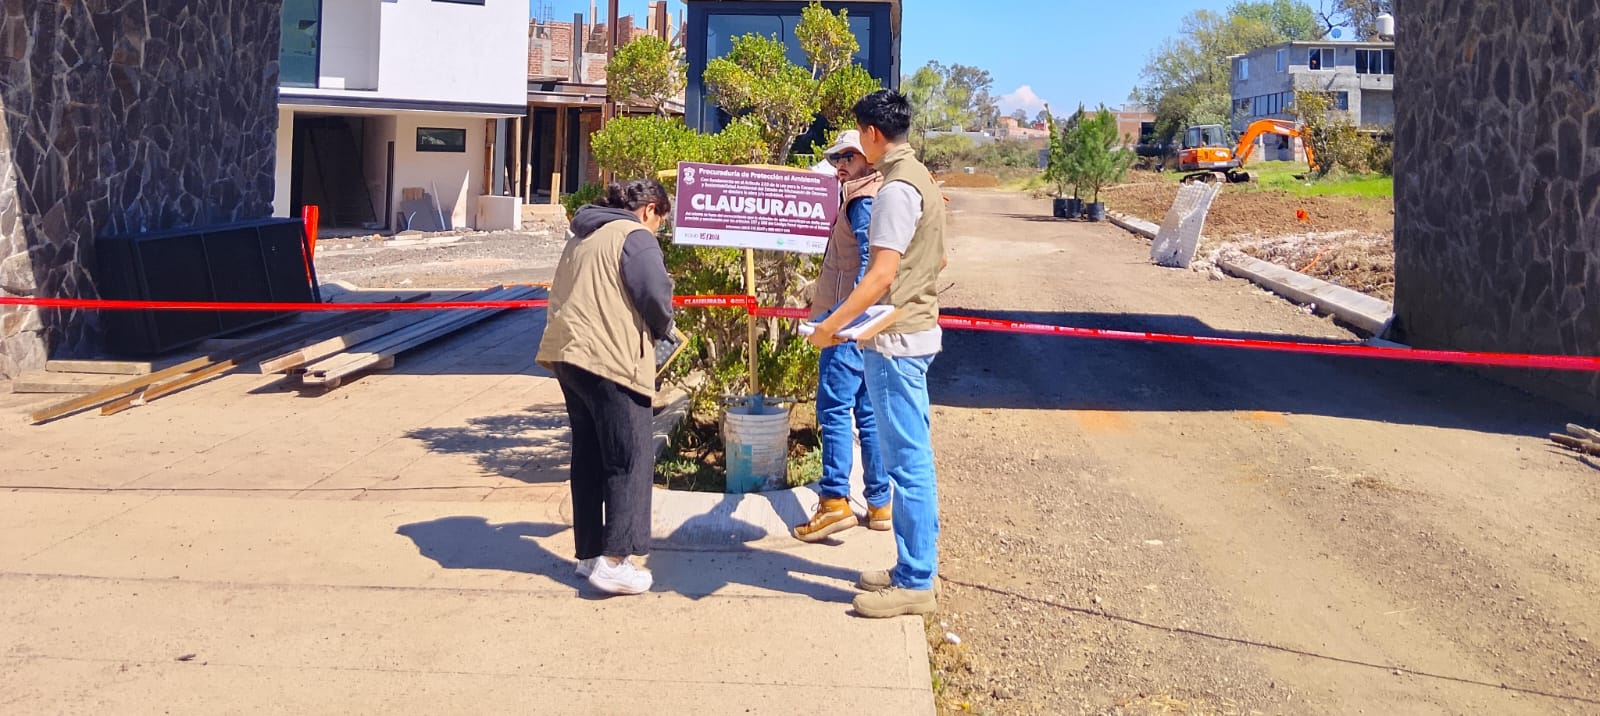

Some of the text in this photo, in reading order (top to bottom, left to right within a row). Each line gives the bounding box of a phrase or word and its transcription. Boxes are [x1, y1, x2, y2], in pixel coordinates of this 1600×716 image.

[698, 167, 740, 177] Procuraduría
[750, 171, 784, 180] Protección
[791, 176, 820, 184] Ambiente
[691, 194, 826, 220] CLAUSURADA
